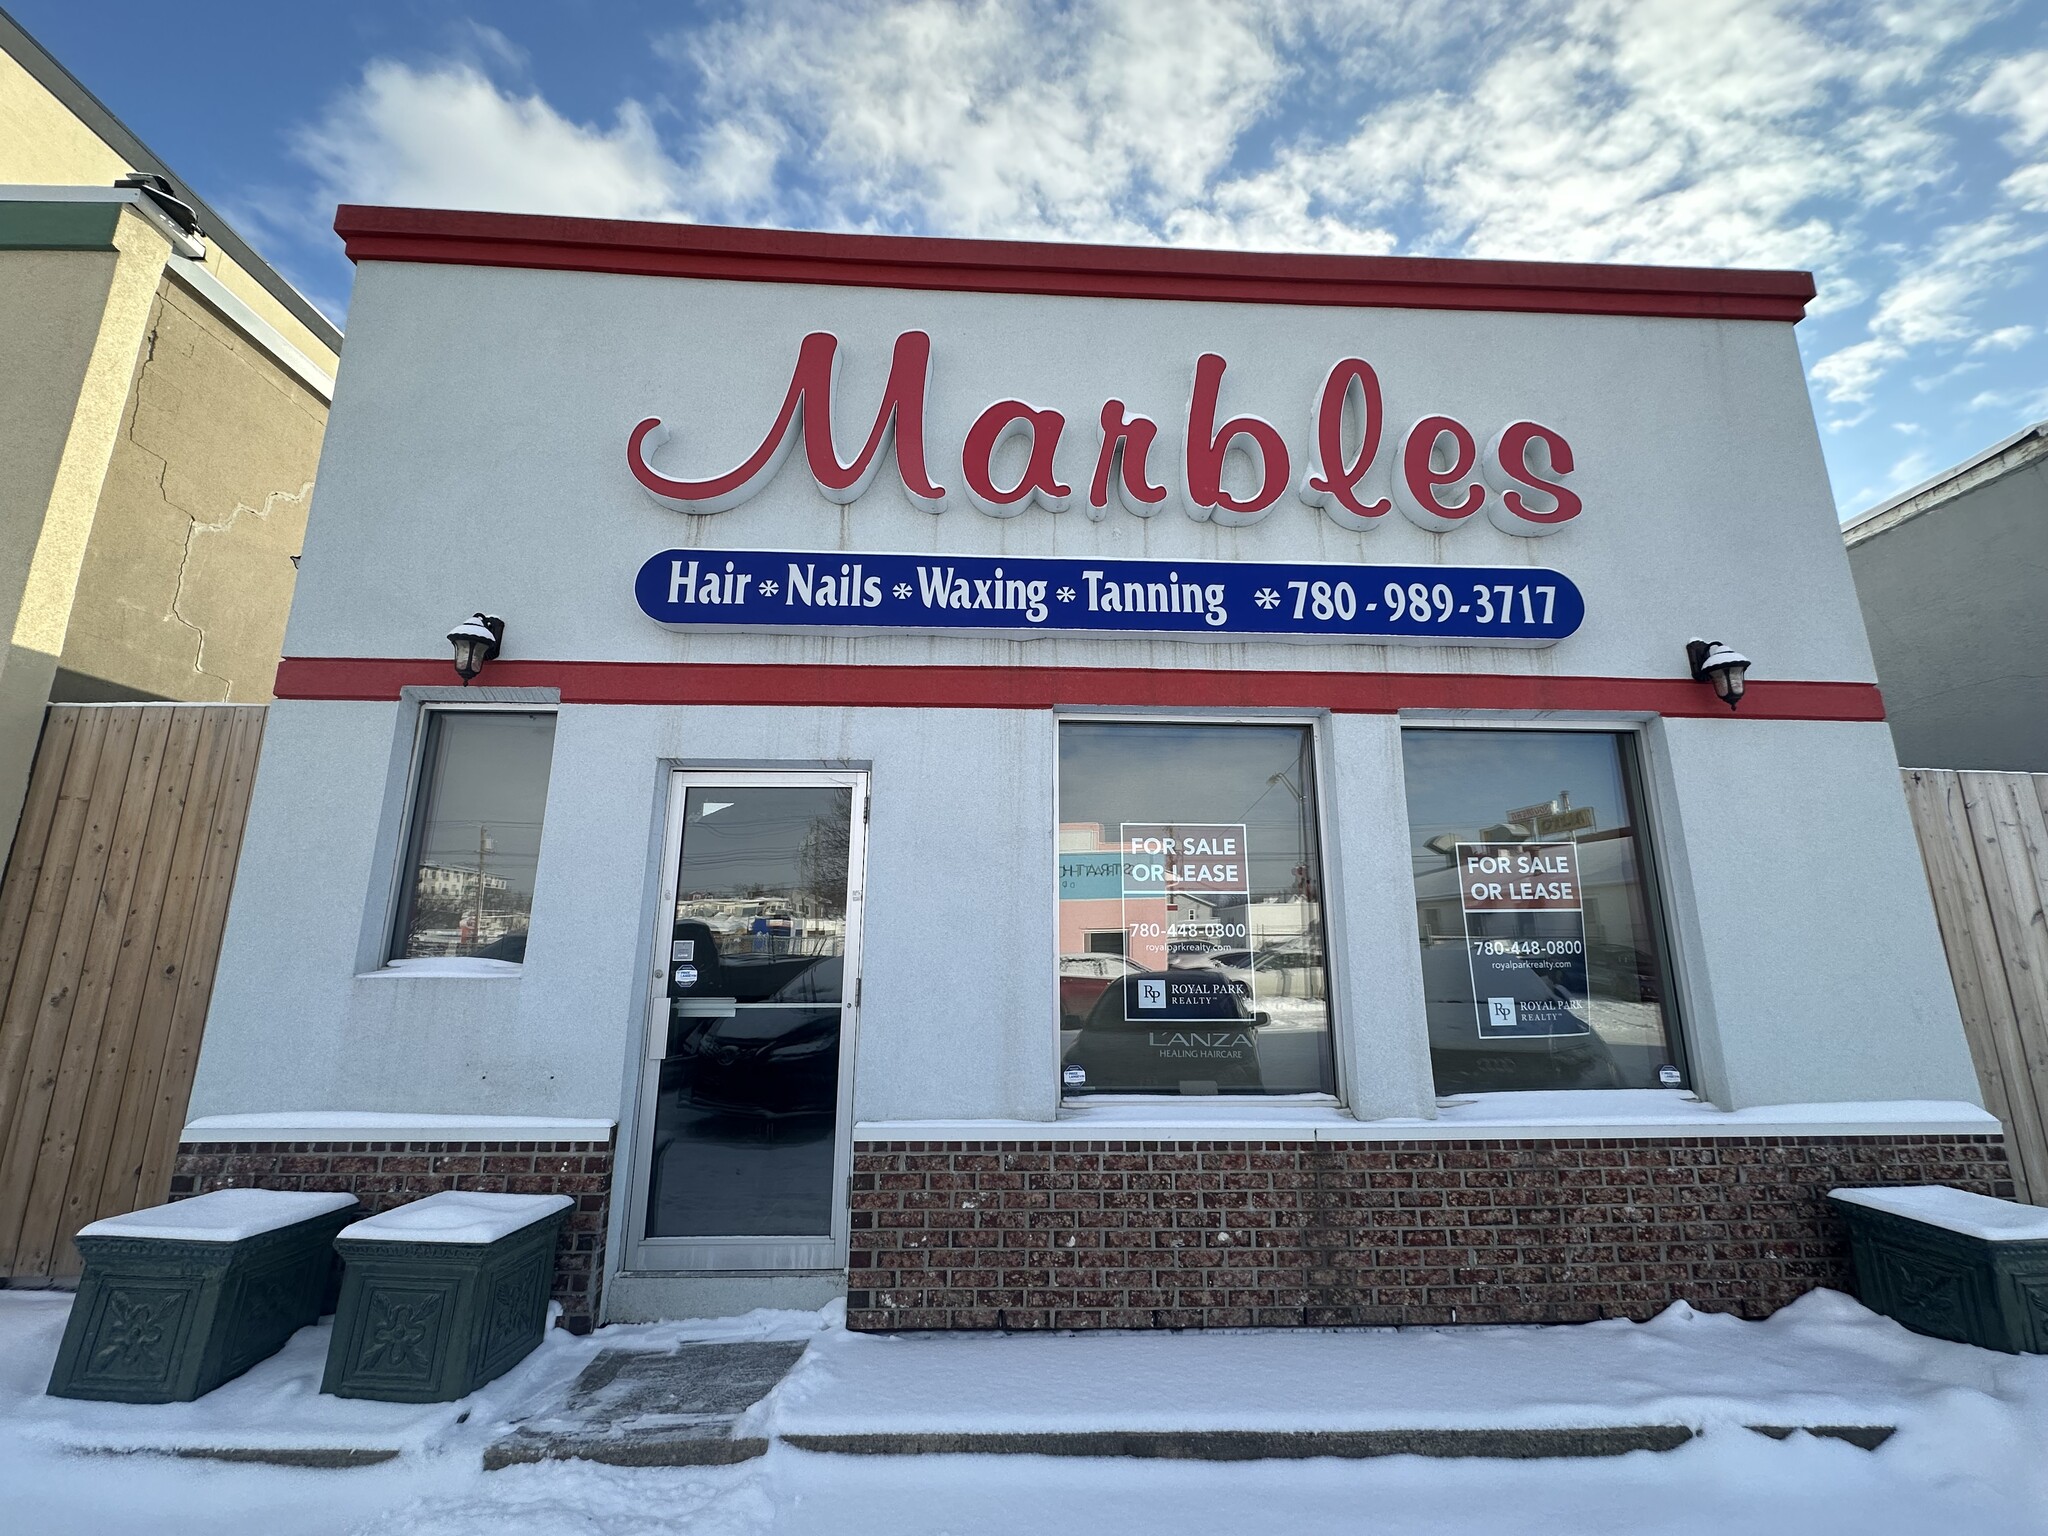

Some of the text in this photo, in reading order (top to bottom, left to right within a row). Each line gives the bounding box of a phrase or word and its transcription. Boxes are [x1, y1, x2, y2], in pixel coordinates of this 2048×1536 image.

[627, 330, 1583, 524] Marbles
[667, 560, 752, 605] Hair
[785, 563, 883, 608] Nails
[916, 566, 1049, 623] Waxing
[1081, 570, 1228, 626] Tanning
[1131, 837, 1237, 856] FOR SALE
[1132, 864, 1239, 882] OR LEASE
[1467, 856, 1570, 874] FOR SALE
[1470, 882, 1574, 900] OR LEASE
[1129, 922, 1246, 938] 780-448-0800
[1145, 942, 1232, 953] royalparkrealty.com
[1474, 940, 1583, 956] 780-448-0800
[1491, 959, 1572, 971] royalparkrealty.com
[1171, 983, 1244, 994] ROYAL PARK
[1520, 1000, 1583, 1011] ROYAL PARK
[1159, 1049, 1243, 1059] HEALING HAIRCARE
